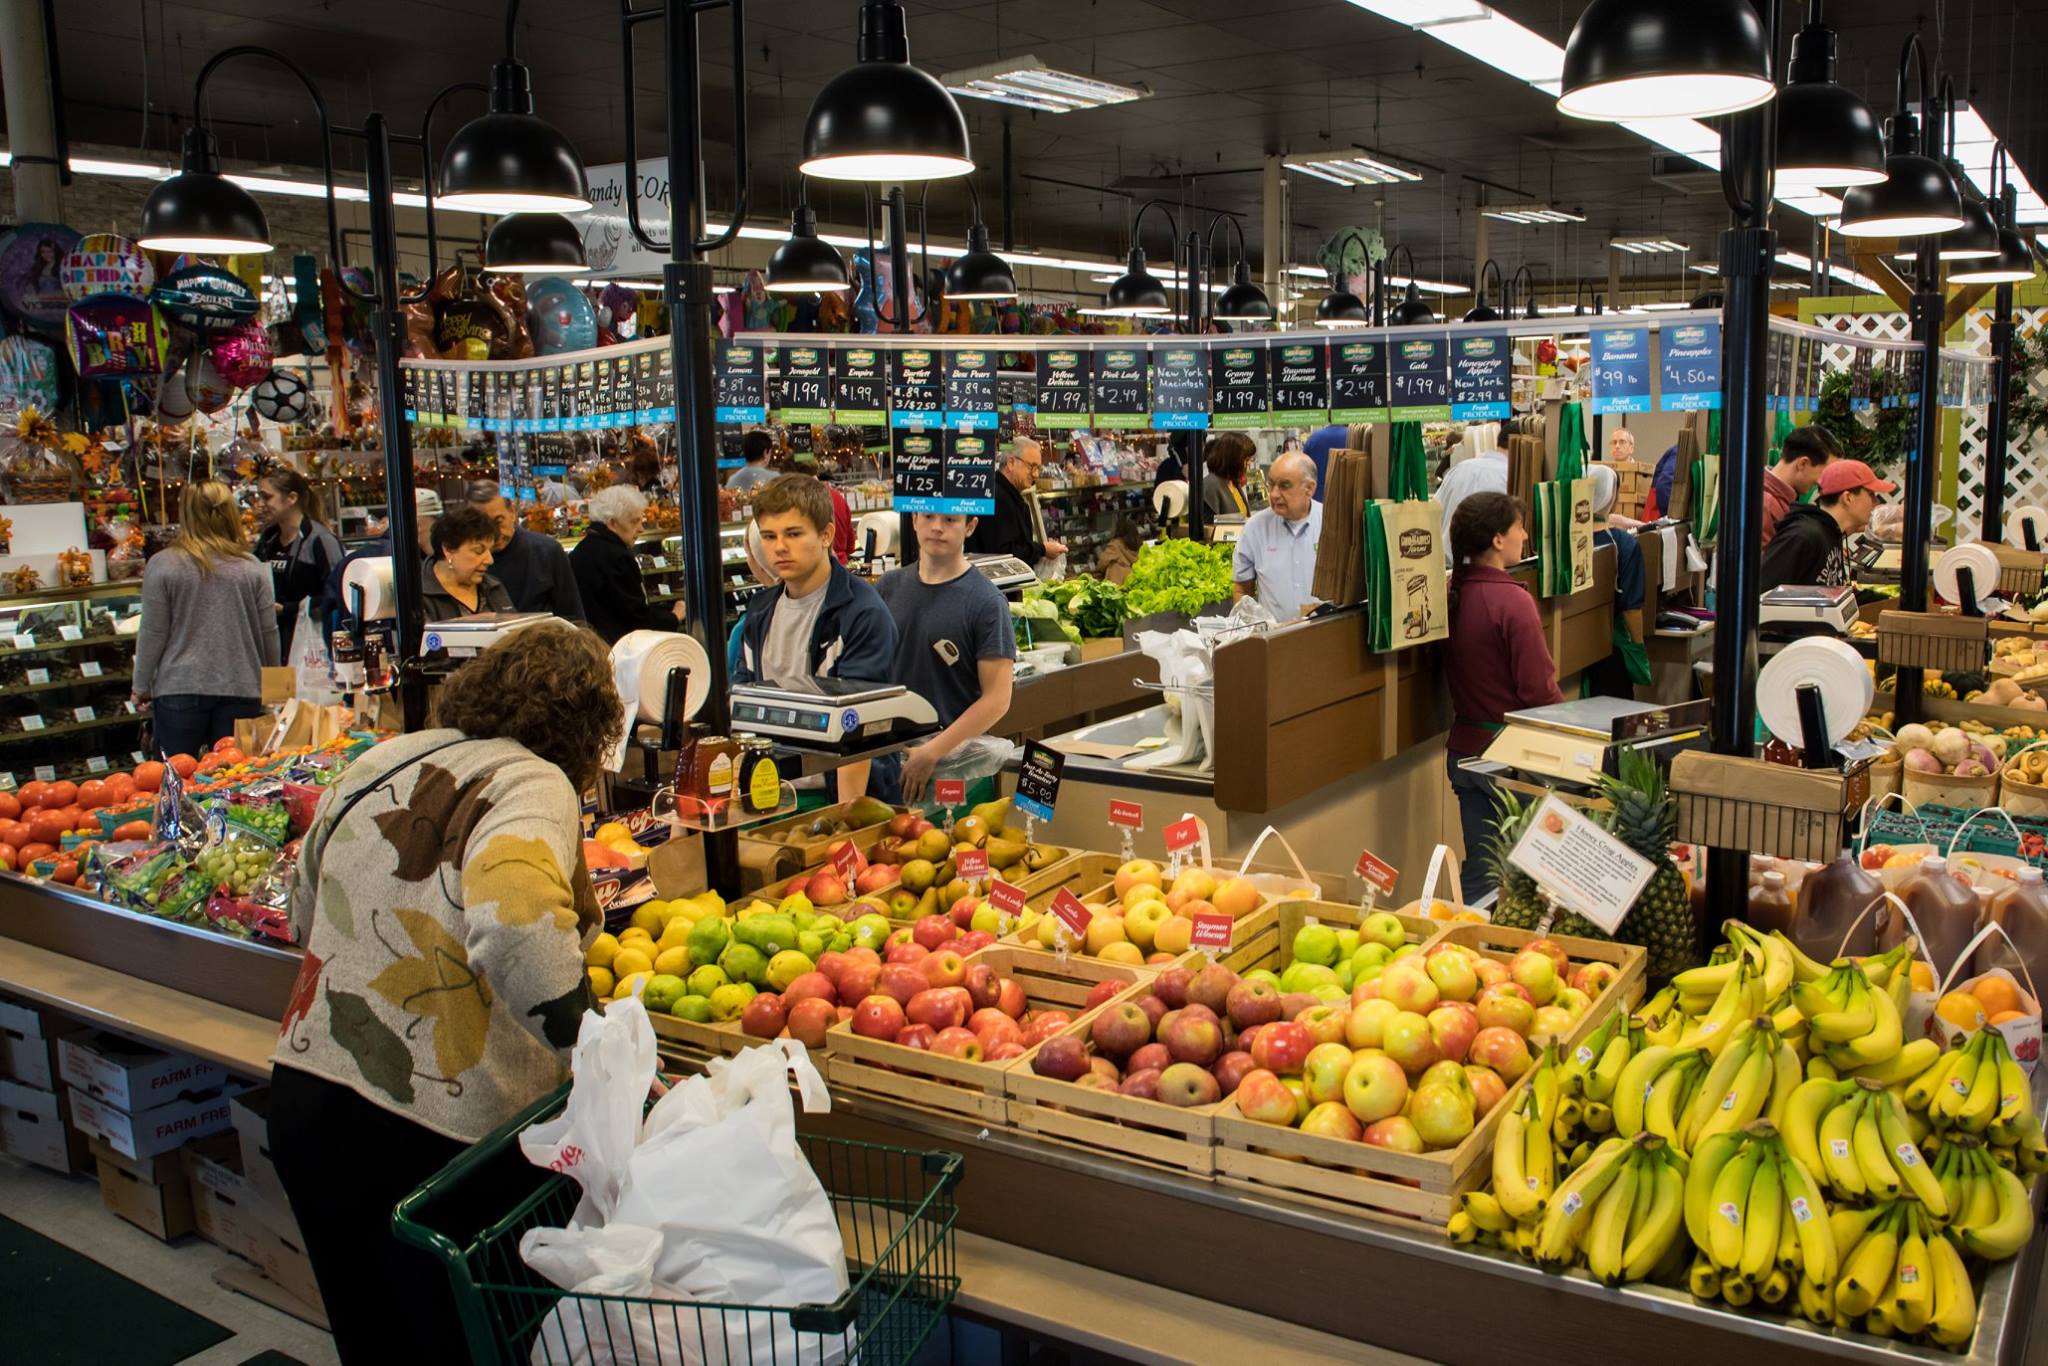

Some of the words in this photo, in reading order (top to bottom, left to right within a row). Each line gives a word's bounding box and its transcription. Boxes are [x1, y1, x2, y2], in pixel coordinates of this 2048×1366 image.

[588, 179, 622, 207] andy
[635, 175, 671, 208] COR
[70, 254, 129, 267] HAPPY
[190, 291, 233, 309] EAGLES
[1602, 352, 1638, 361] Bananas
[1669, 348, 1712, 357] Pineapples
[1351, 364, 1368, 374] Fuji
[1409, 361, 1429, 370] Gala
[1458, 359, 1501, 369] Honeycrisp
[728, 367, 752, 375] Lemons
[788, 367, 821, 377] Jonagold
[848, 369, 874, 377] Empire
[902, 369, 931, 378] Bartlett
[970, 370, 990, 379] Pears
[1051, 371, 1075, 379] Yellow
[1101, 371, 1120, 379] Pink
[1120, 371, 1140, 381] Lady
[1157, 367, 1177, 379] New
[1182, 367, 1203, 378] York
[1225, 370, 1254, 379] Granny
[1282, 367, 1316, 376] Stayman
[1466, 367, 1493, 375] Apples
[906, 377, 927, 385] Pears
[1047, 378, 1079, 386] Delicious
[1159, 378, 1204, 389] Macintosh
[1228, 377, 1251, 385] Smith
[1283, 374, 1316, 383] Winesap
[1454, 379, 1475, 389] New
[1478, 377, 1504, 387] York
[1335, 379, 1375, 397] $2.49
[1396, 376, 1433, 395] $1.99
[781, 380, 819, 403] $1.99
[840, 384, 872, 401] $1.99
[1097, 386, 1138, 404] $2.49
[1457, 391, 1493, 402] $2.99
[1040, 391, 1081, 410] $1.99
[1215, 390, 1254, 409] $1.99
[1277, 390, 1314, 406] $1.99
[1602, 404, 1641, 412] PRODUCE
[1671, 401, 1710, 409] PRODUCE
[1462, 410, 1500, 418] PRODUCE
[1162, 419, 1199, 427] PRODUCE
[972, 457, 993, 466] Pears
[908, 463, 928, 471] Pears
[896, 474, 934, 491] $1.25
[947, 469, 987, 488] $2.29
[951, 505, 985, 513] PRODUCE
[1196, 921, 1228, 931] Stayman
[152, 1068, 192, 1089] FARM
[156, 1116, 197, 1138] FARM
